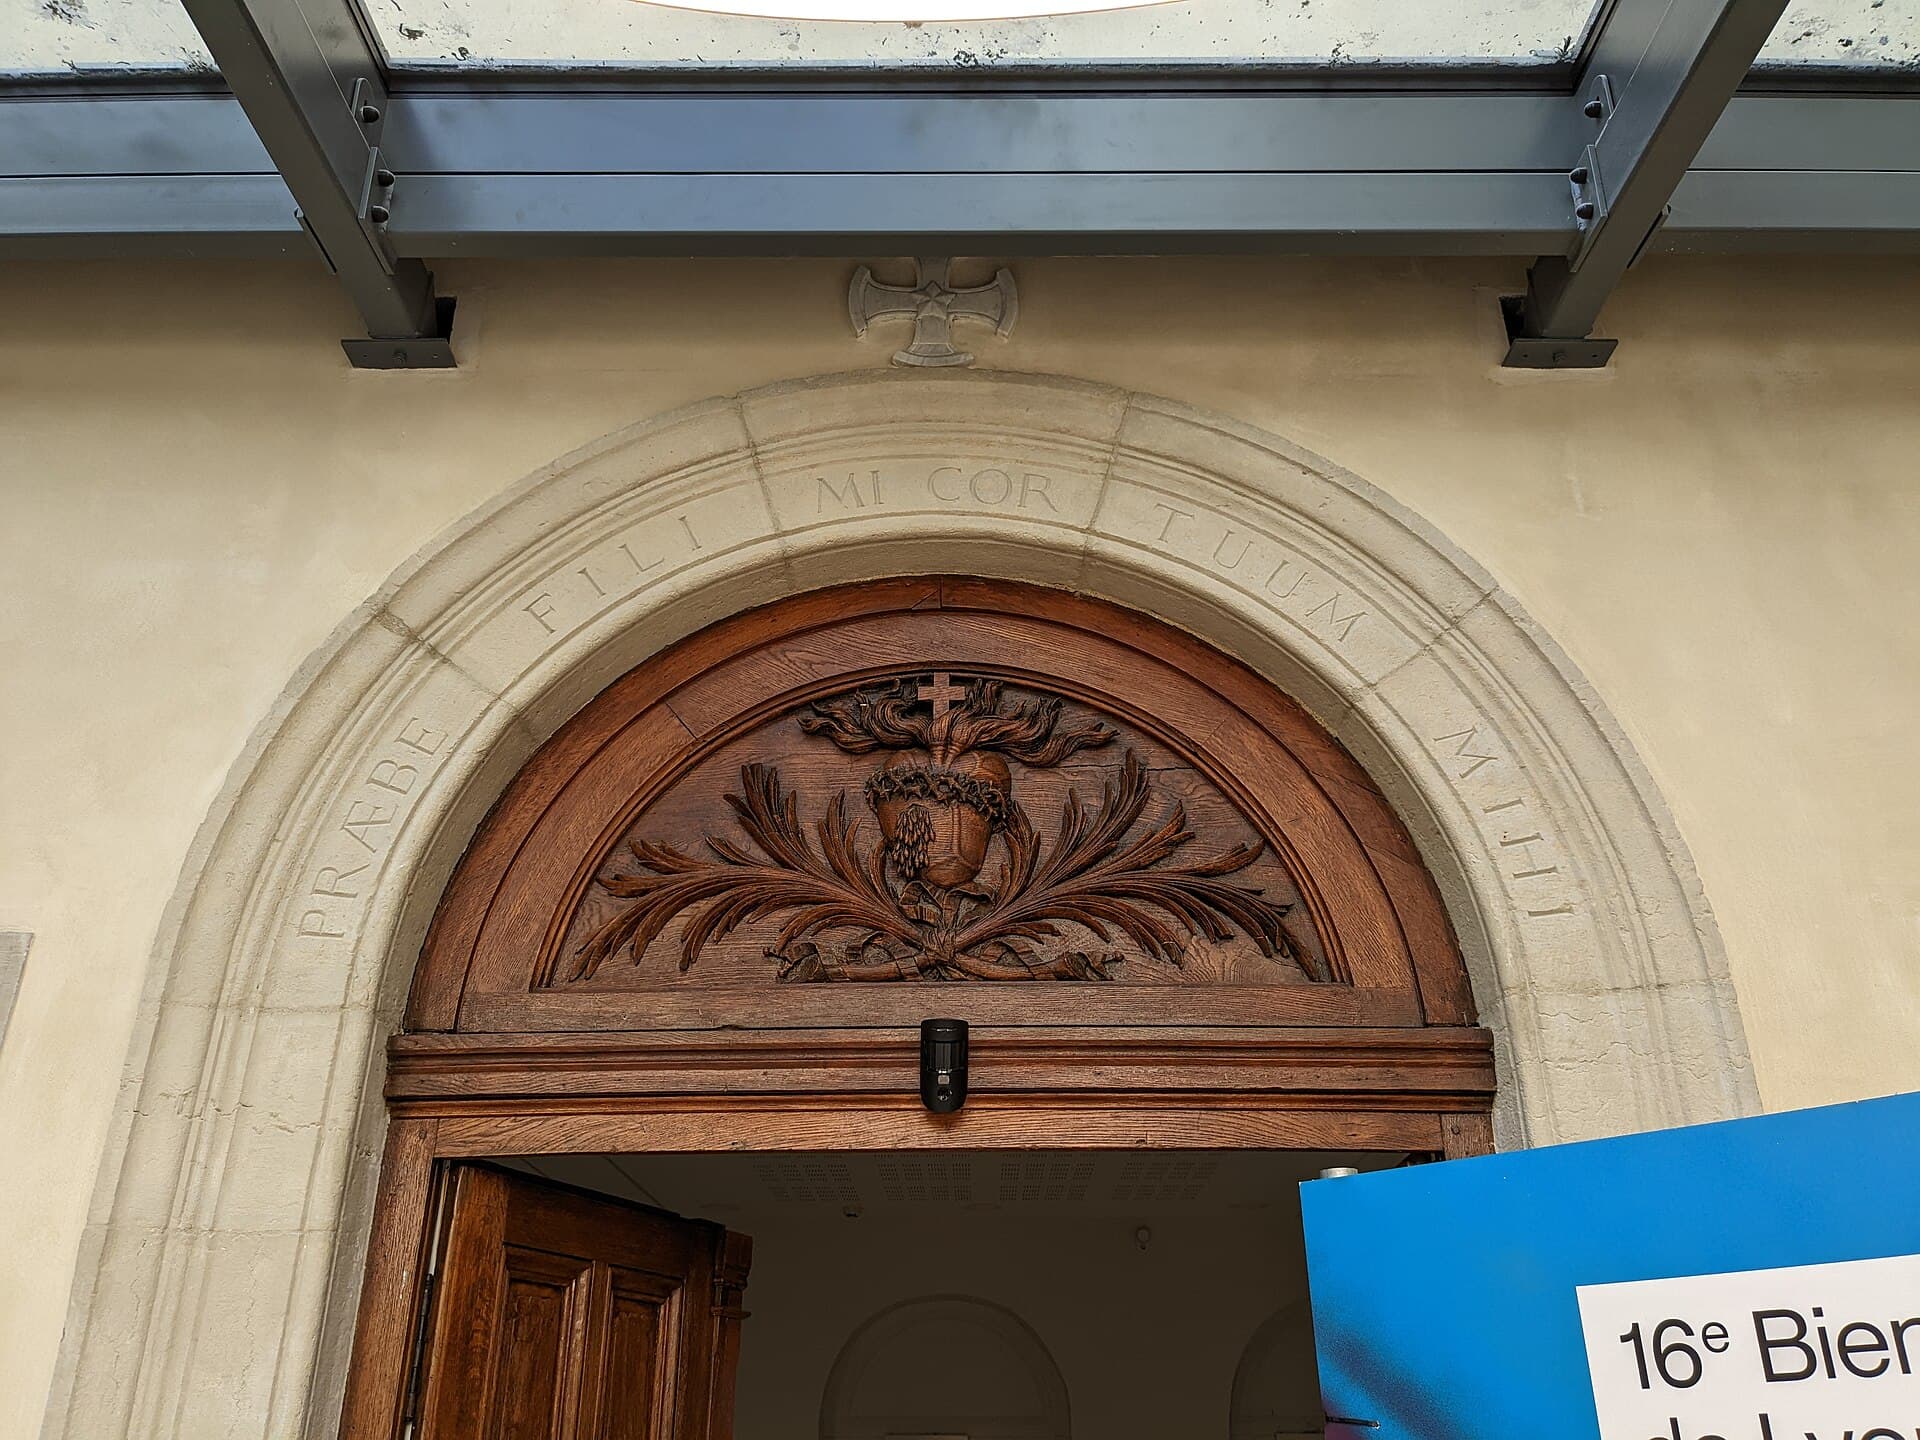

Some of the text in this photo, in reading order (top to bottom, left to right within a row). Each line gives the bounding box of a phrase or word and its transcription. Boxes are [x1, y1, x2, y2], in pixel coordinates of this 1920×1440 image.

[522, 515, 702, 635] FILI
[816, 469, 885, 514] MI
[927, 466, 1059, 513] COR
[1154, 503, 1369, 642] TUUM
[1433, 727, 1576, 918] MIHI
